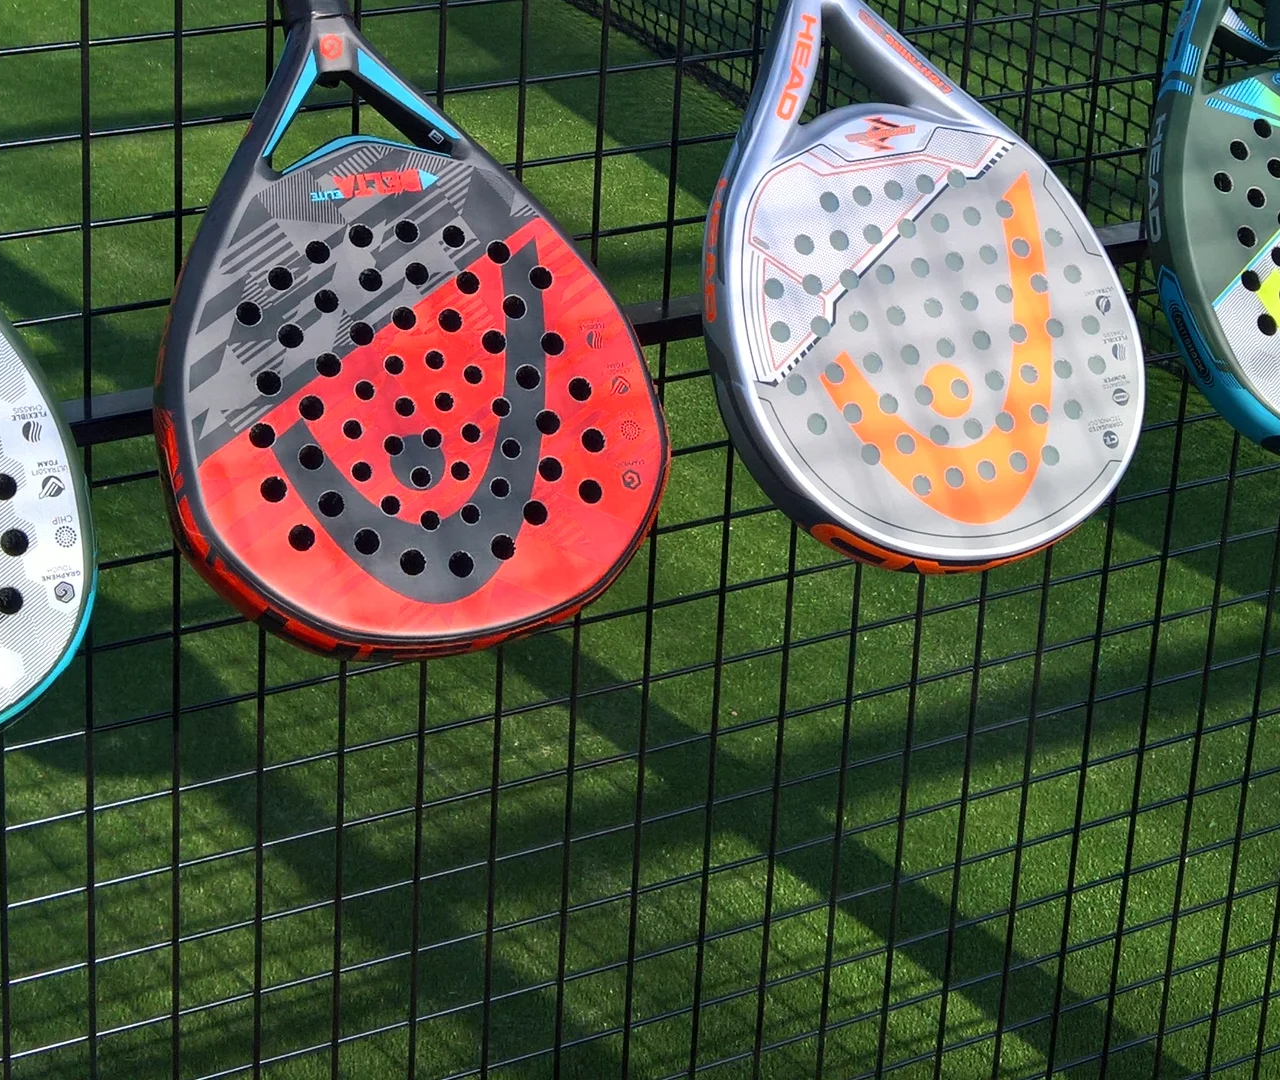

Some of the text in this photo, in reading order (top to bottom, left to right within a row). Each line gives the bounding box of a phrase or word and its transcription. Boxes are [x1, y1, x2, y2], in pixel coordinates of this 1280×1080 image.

[776, 12, 817, 121] HEAD
[1147, 112, 1167, 244] HEAD
[310, 168, 422, 202] DELTA ELITE
[11, 404, 42, 413] CHASSIS
[11, 410, 46, 421] FLEXIBLE
[37, 459, 57, 467] FOAM
[51, 514, 72, 524] CHIP
[46, 564, 72, 573] TOUCH
[41, 569, 80, 581] GRAPHENE
